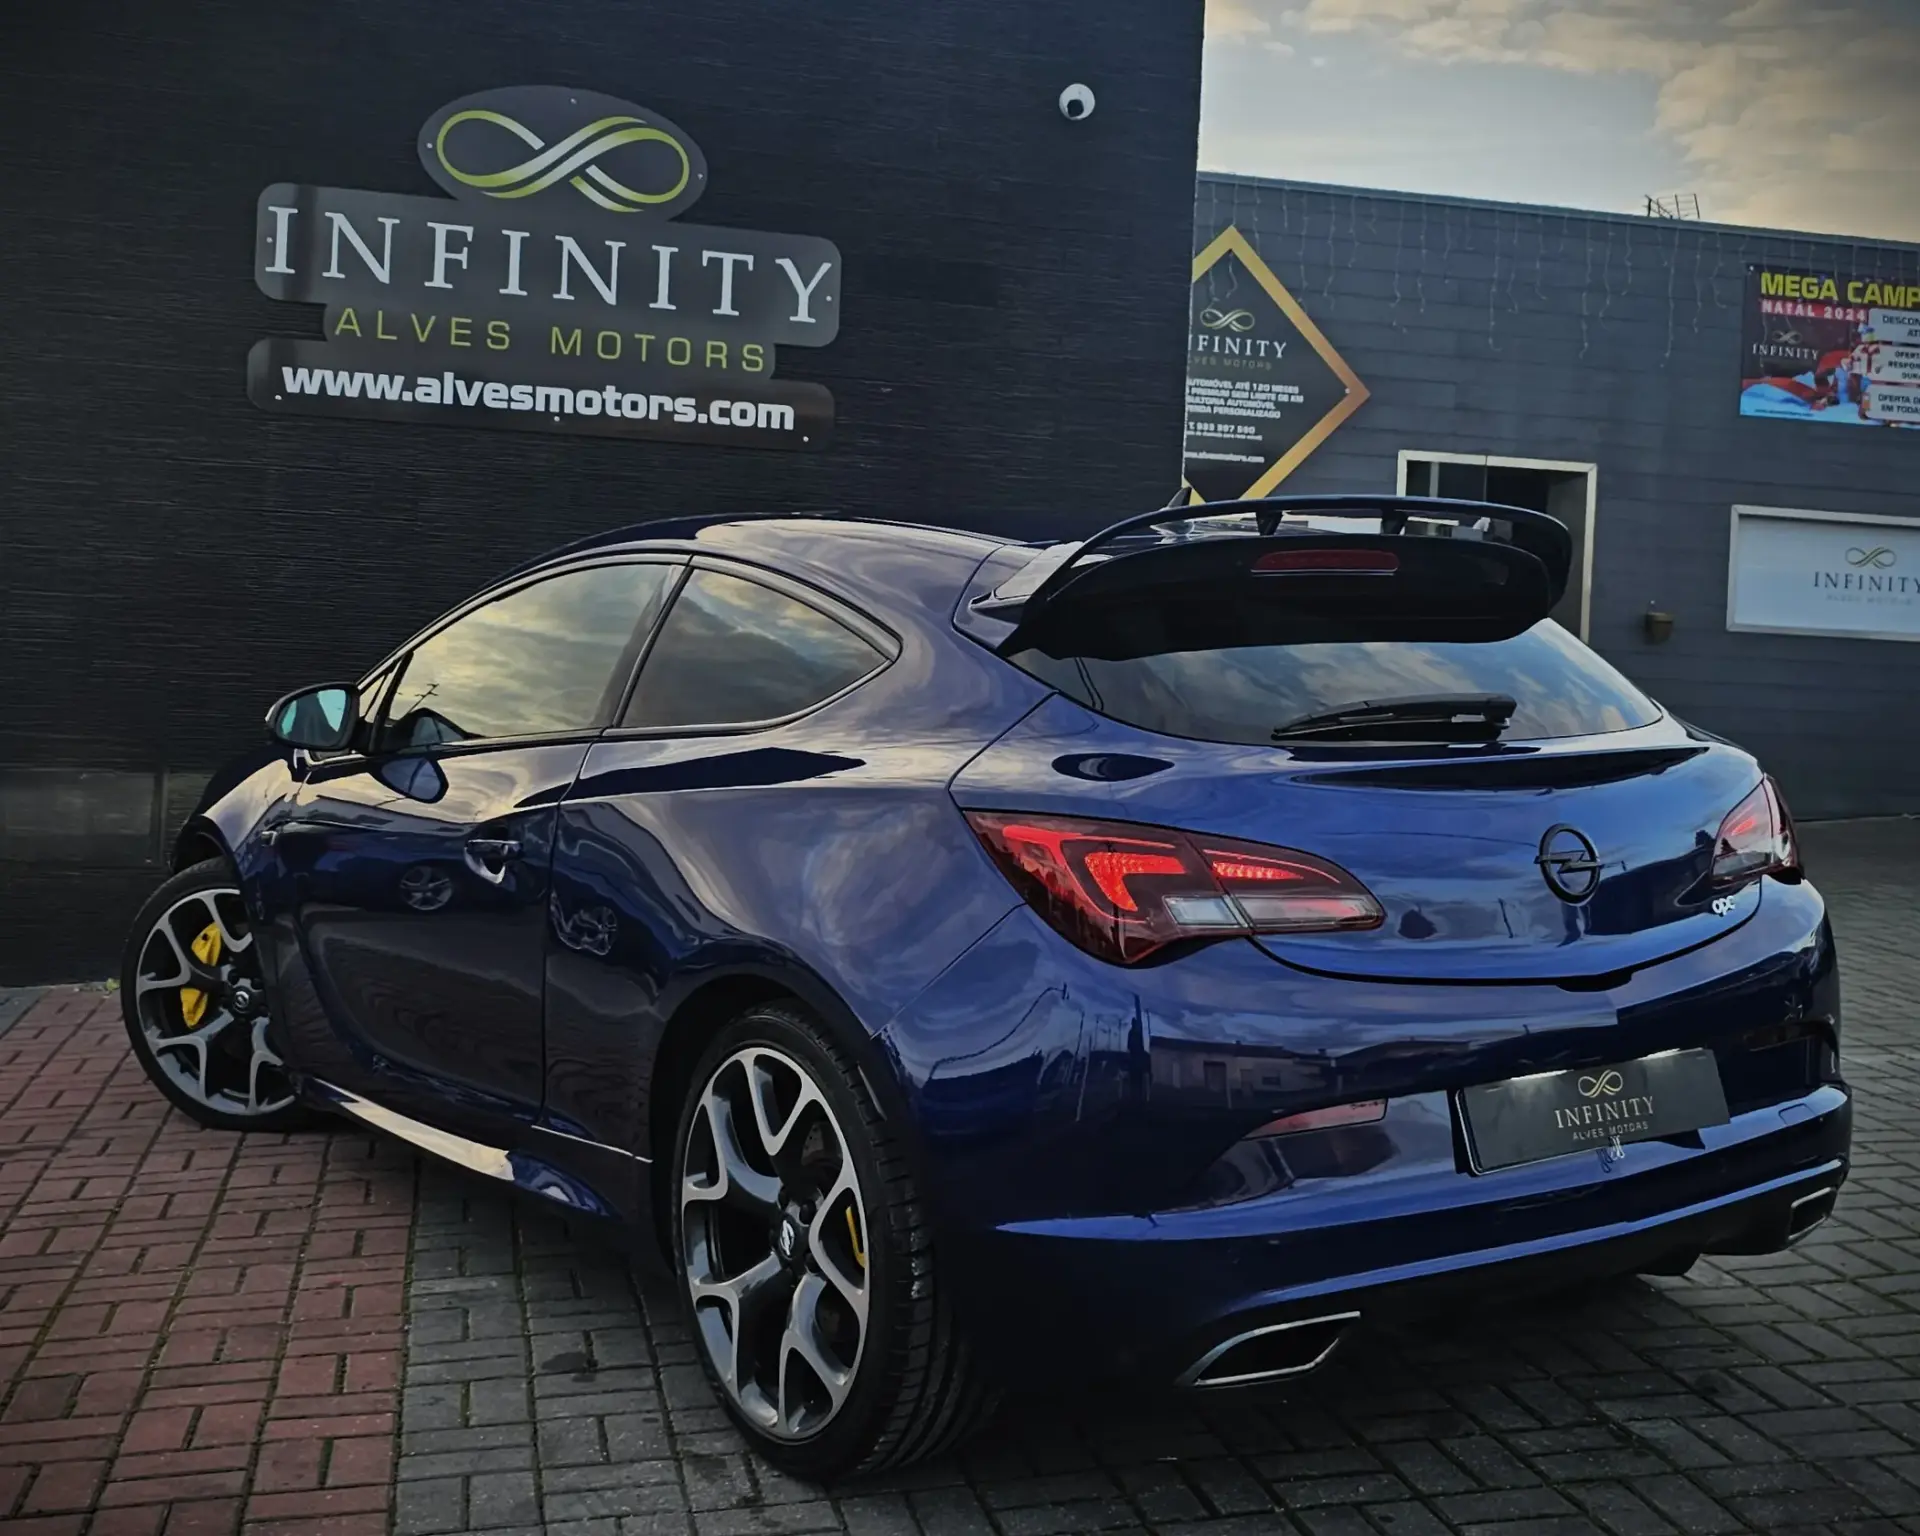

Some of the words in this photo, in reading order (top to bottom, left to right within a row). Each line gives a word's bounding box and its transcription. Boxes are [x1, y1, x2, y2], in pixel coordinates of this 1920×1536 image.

[264, 205, 832, 324] INFINITY
[1761, 272, 1839, 301] MEGA
[1847, 281, 1920, 308] CAMP
[1761, 299, 1815, 317] NATAL
[1824, 306, 1866, 322] 2024
[335, 307, 510, 350] ALVES
[550, 326, 765, 373] MOTORS
[1752, 343, 1818, 361] INFINITY
[281, 365, 795, 431] www.alvesmotors.com
[1813, 571, 1920, 594] INFINITY
[1554, 1096, 1654, 1129] INFINITY
[1572, 1127, 1604, 1141] ALVES
[1609, 1120, 1649, 1136] MOTORS
